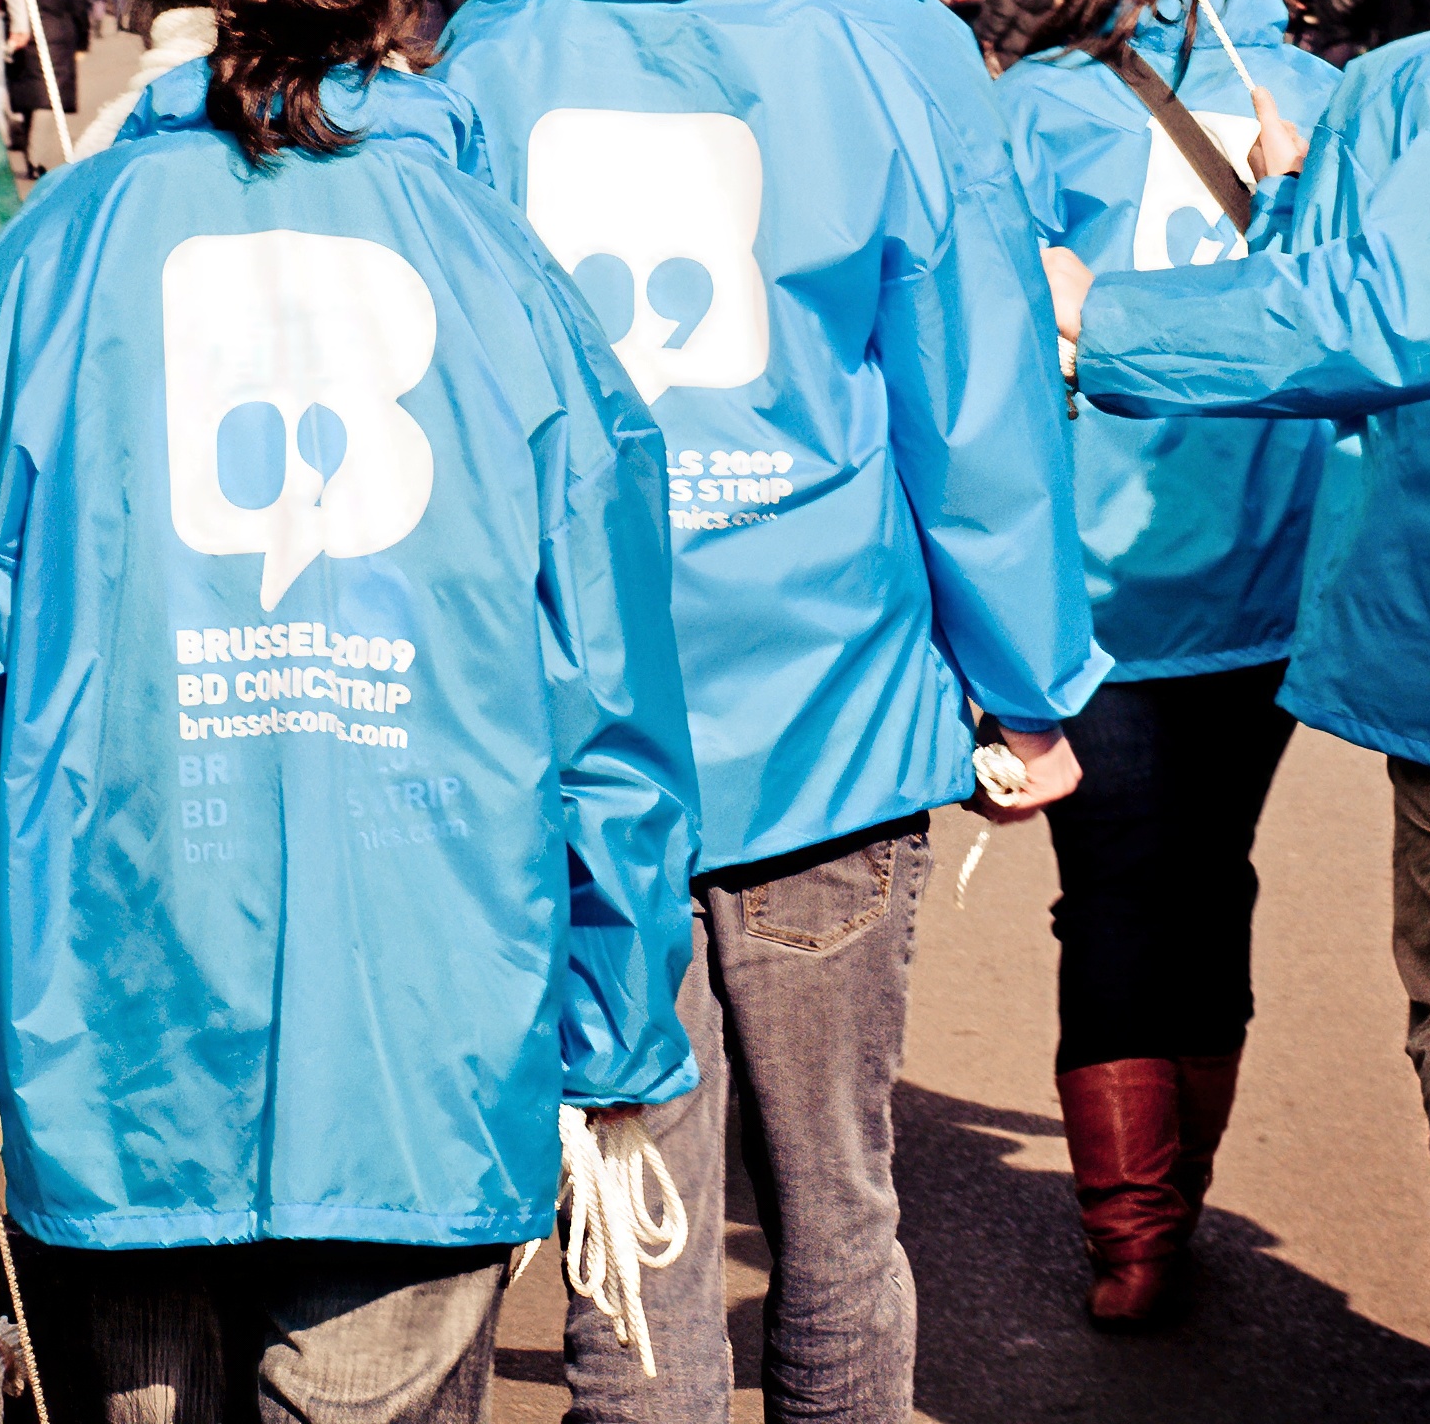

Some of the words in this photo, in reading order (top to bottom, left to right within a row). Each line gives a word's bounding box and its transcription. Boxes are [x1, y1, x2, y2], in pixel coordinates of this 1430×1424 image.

[709, 450, 794, 476] 2009
[697, 478, 793, 505] STRIP
[176, 622, 332, 664] BRUSSEL
[331, 632, 416, 673] 2009
[177, 673, 228, 706] BD
